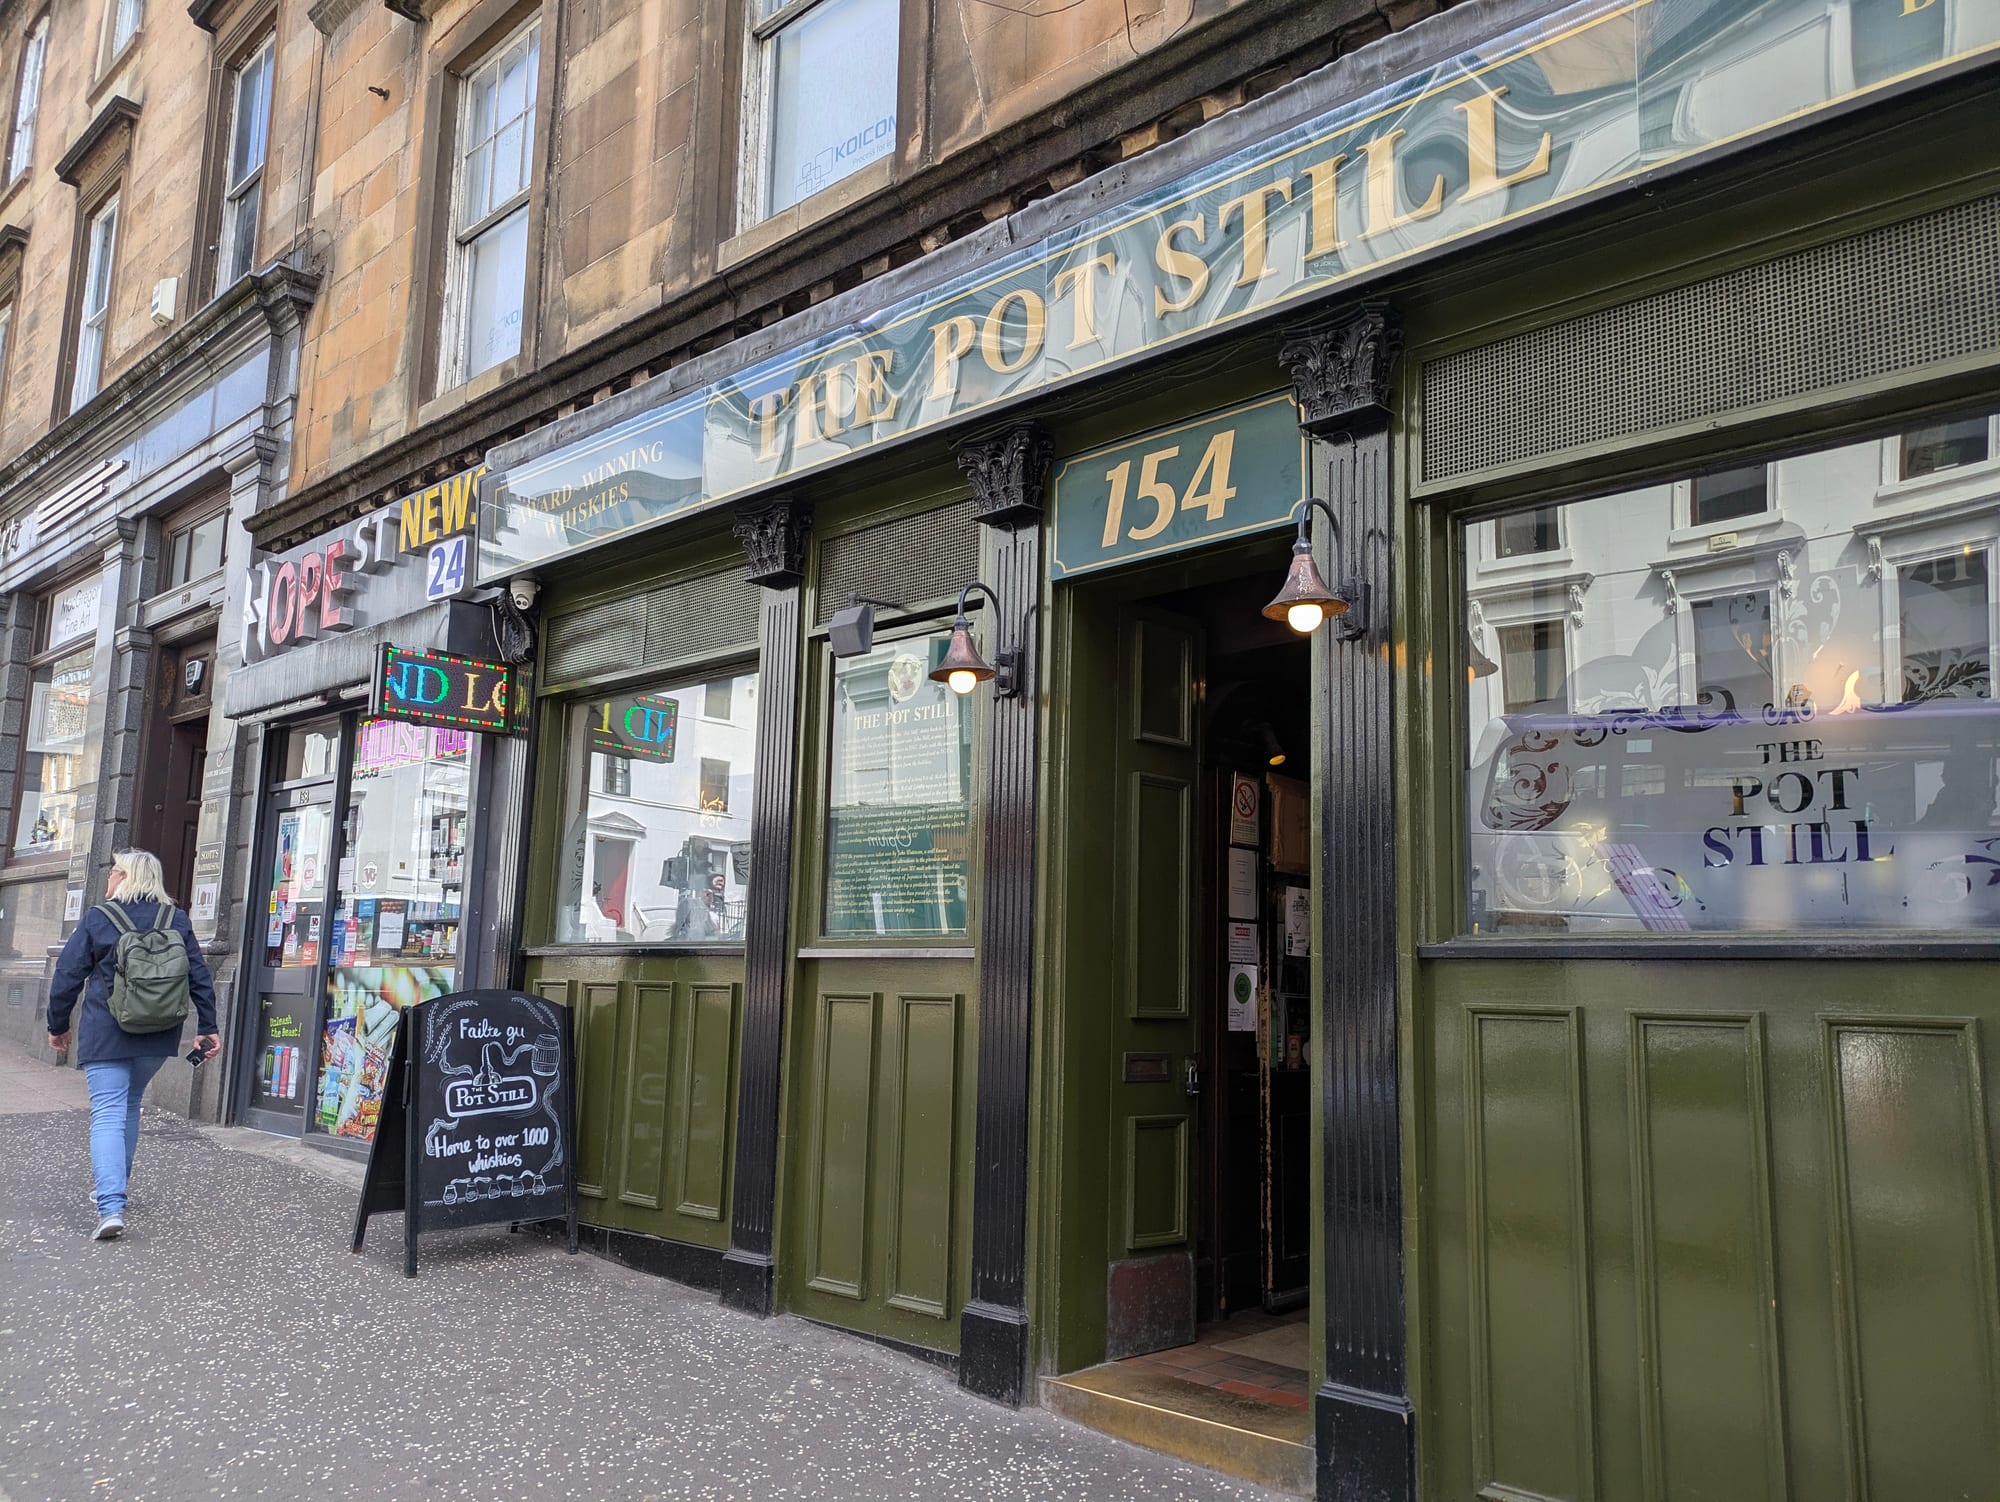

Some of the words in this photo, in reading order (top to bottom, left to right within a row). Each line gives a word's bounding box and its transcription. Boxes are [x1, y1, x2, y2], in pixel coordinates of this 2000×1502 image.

[748, 349, 898, 464] THE
[925, 251, 1117, 402] POT
[1154, 85, 1552, 319] STILL
[544, 481, 629, 537] WHISKIES
[1101, 429, 1238, 548] 154
[353, 507, 394, 572] ST
[428, 538, 465, 597] 24
[854, 713, 880, 729] THE
[885, 709, 910, 726] POT
[914, 702, 954, 721] STILL
[1756, 738, 1824, 764] THE
[1728, 767, 1859, 816] POT
[1703, 818, 1895, 869] STILL
[455, 1088, 486, 1107] POT
[487, 1085, 529, 1104] STILL
[435, 1135, 473, 1158] Home
[475, 1134, 490, 1150] to
[494, 1133, 520, 1149] over
[522, 1127, 549, 1147] 1000
[468, 1150, 523, 1173] whiskies
